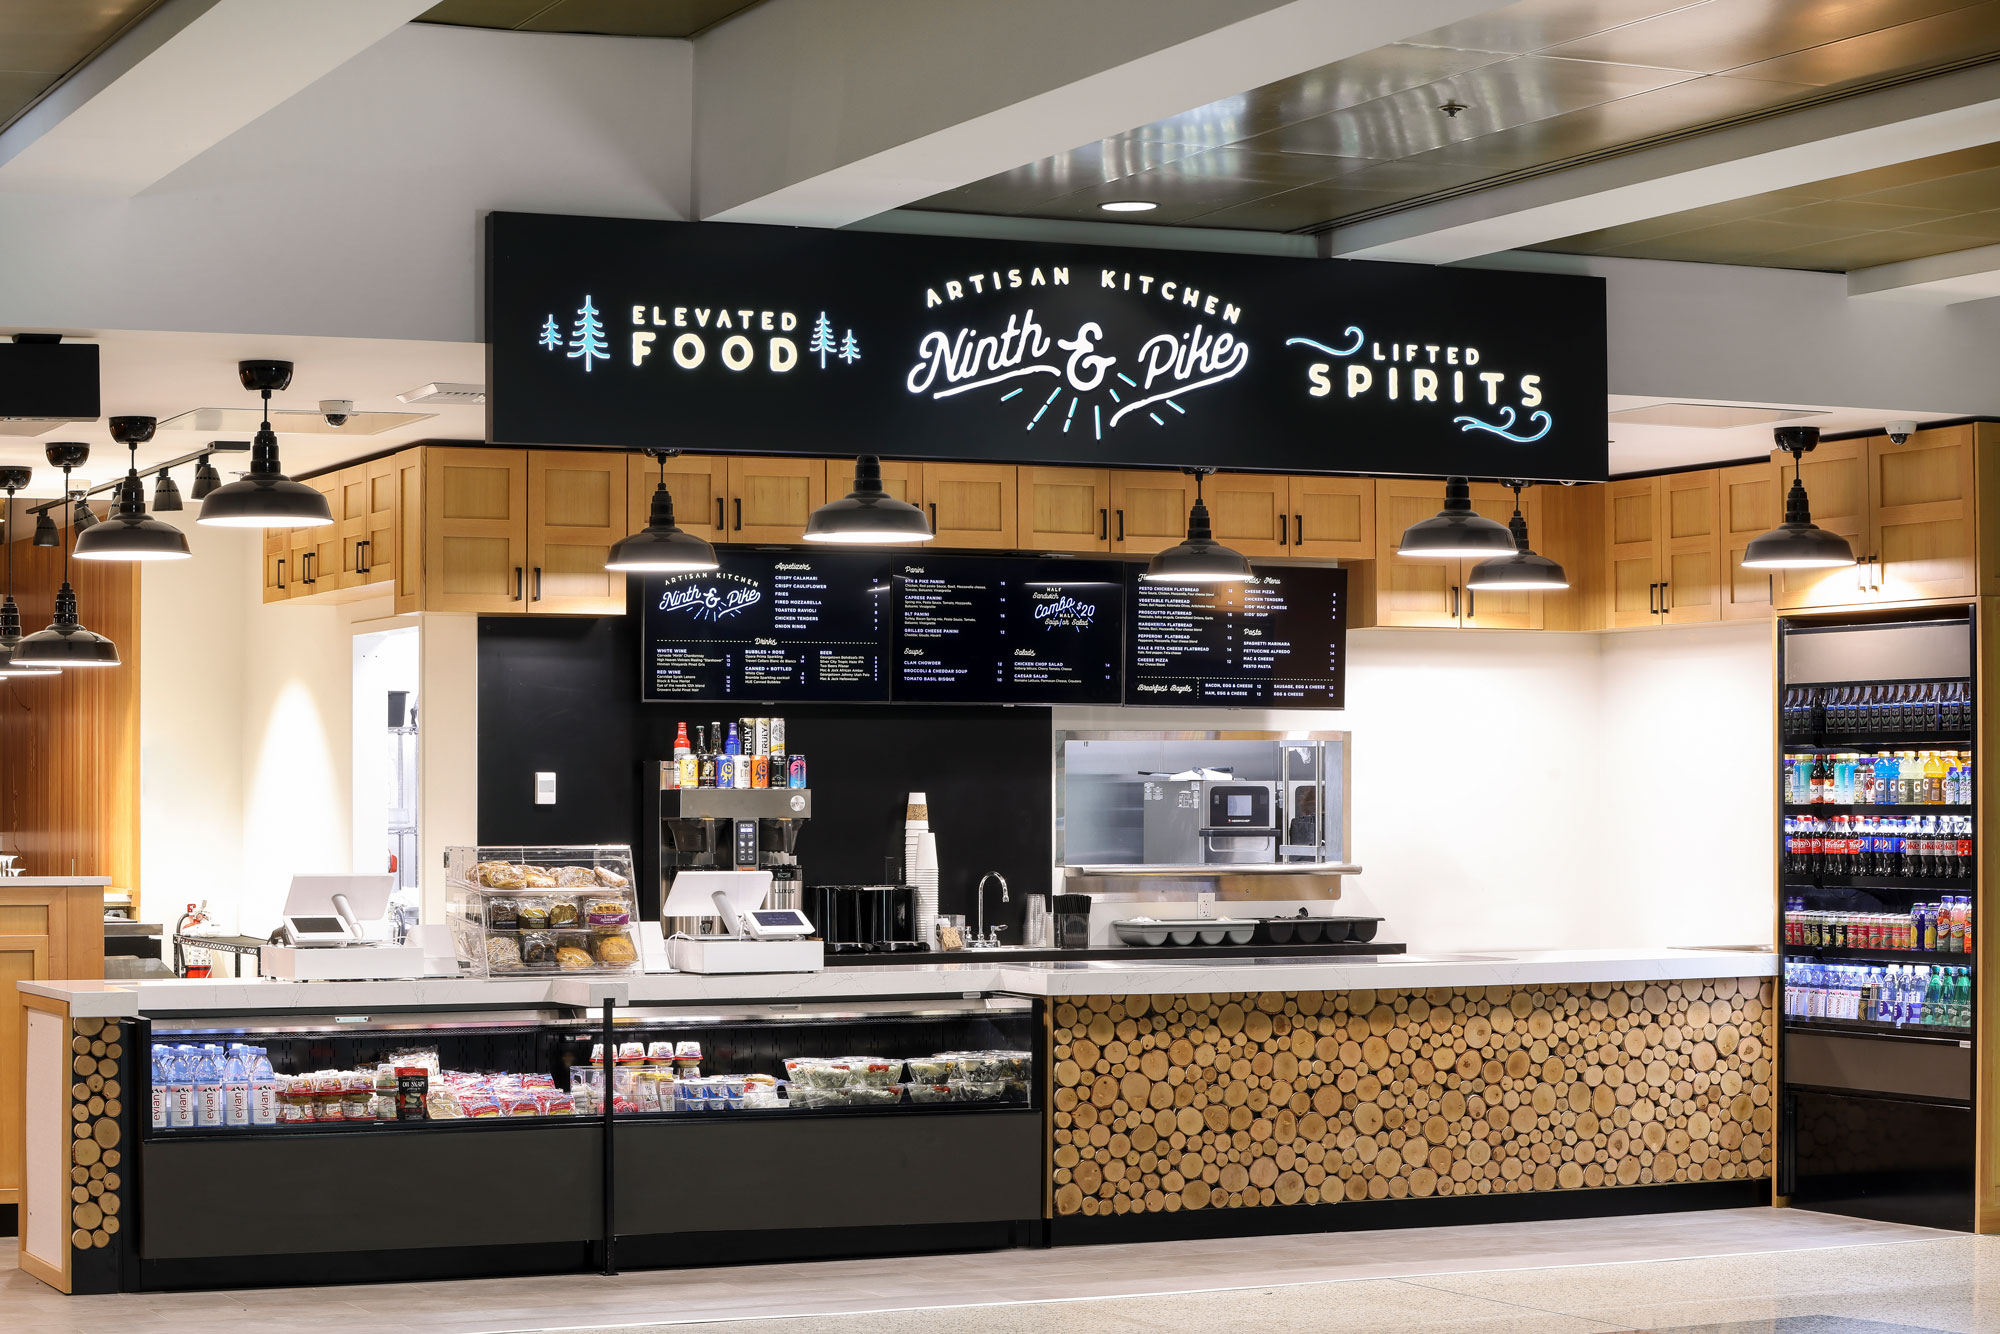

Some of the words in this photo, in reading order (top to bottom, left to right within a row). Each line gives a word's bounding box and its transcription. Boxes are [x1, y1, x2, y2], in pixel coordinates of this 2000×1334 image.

[926, 267, 1070, 308] ARTISAN
[1101, 269, 1242, 325] KITCHEN
[632, 305, 797, 331] ELEVATED
[632, 331, 798, 372] FOOD
[907, 309, 1053, 395] Ninth
[1057, 321, 1117, 391] &
[1128, 324, 1249, 403] Pike
[1373, 342, 1480, 366] LIFTED
[1308, 363, 1542, 407] SPIRITS
[775, 562, 811, 571] Appetizers
[905, 566, 924, 574] Panini
[665, 572, 708, 586] ARTISAN
[716, 572, 759, 587] KITCHEN
[1264, 577, 1281, 585] Menu
[659, 584, 702, 610] Ninth
[703, 587, 721, 608] &
[724, 587, 761, 611] Pike
[1032, 592, 1059, 600] Sandwich
[1034, 596, 1076, 619] Combo
[1076, 601, 1096, 617] $20
[1244, 628, 1262, 636] Pasta
[754, 638, 777, 646] Drinks
[904, 648, 924, 656] Soups
[1014, 649, 1036, 657] Salads
[1137, 684, 1168, 694] Breakfast
[1170, 684, 1193, 694] Bagels
[744, 727, 752, 755] TRULY
[1875, 780, 1885, 791] G
[1889, 781, 1896, 792] G
[1898, 781, 1906, 792] G
[1913, 781, 1921, 792] G
[1923, 778, 1929, 790] G
[152, 1093, 160, 1121] evian
[179, 1093, 187, 1119] evian
[206, 1093, 214, 1119] evian
[234, 1092, 242, 1118] evian
[261, 1091, 269, 1117] evian
